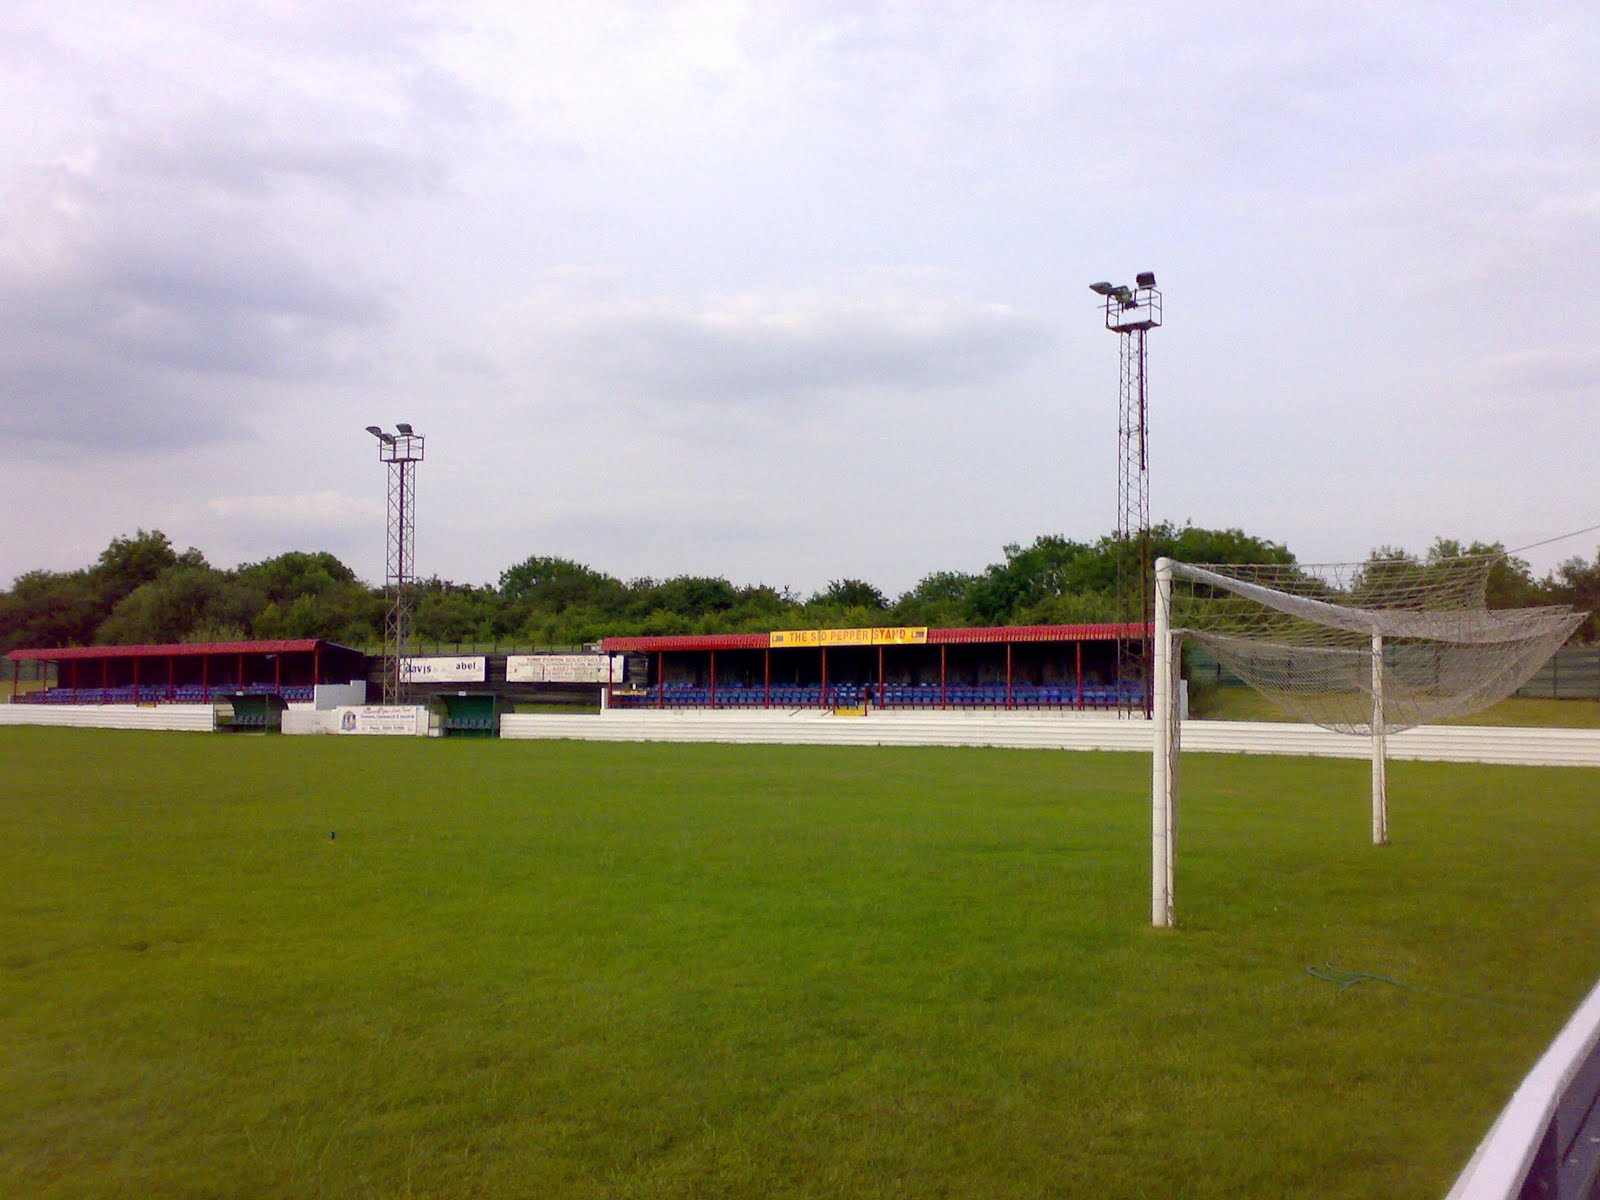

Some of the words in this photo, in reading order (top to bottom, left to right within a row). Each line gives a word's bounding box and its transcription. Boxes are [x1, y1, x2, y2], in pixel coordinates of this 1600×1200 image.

[790, 631, 807, 642] THE
[830, 629, 869, 641] PEPPER
[873, 628, 906, 640] STAND
